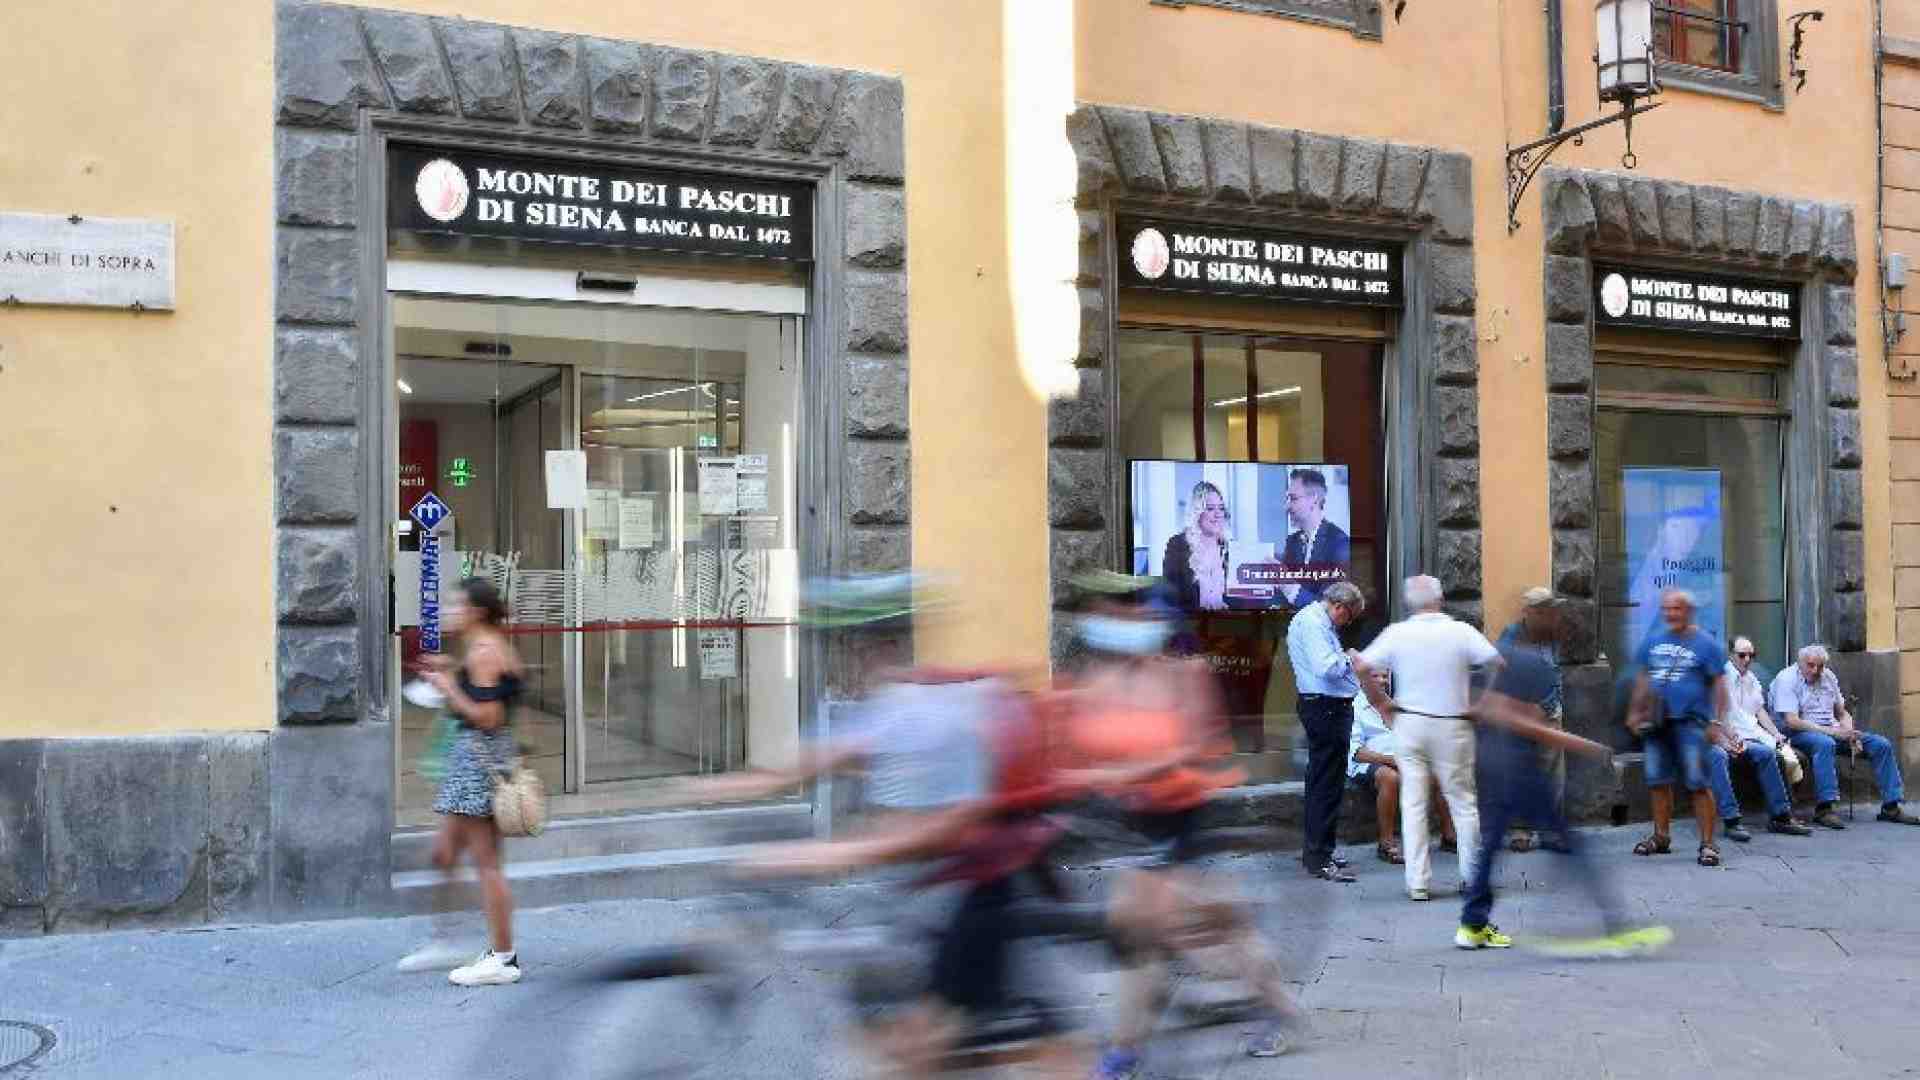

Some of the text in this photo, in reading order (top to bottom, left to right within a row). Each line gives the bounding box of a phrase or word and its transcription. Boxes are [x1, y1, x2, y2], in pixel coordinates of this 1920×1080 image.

[477, 168, 790, 217] MONTE DEI PASCHI
[478, 198, 514, 222] DI
[527, 203, 626, 231] SIENA
[636, 218, 702, 237] BANCA
[710, 224, 749, 241] DAL
[71, 254, 90, 267] DI
[98, 255, 156, 272] SOPRA
[1173, 234, 1387, 272] MONTE DEI PASCHI
[1173, 259, 1200, 278] DI
[1207, 261, 1276, 286] SIENA
[1282, 273, 1328, 288] BANCA
[1332, 277, 1360, 291] DAL
[1631, 278, 1788, 309] MONTE DEI PASCHI
[1632, 300, 1651, 317] DI
[1655, 302, 1707, 321] SIENA
[420, 531, 441, 652] BANCOMAT
